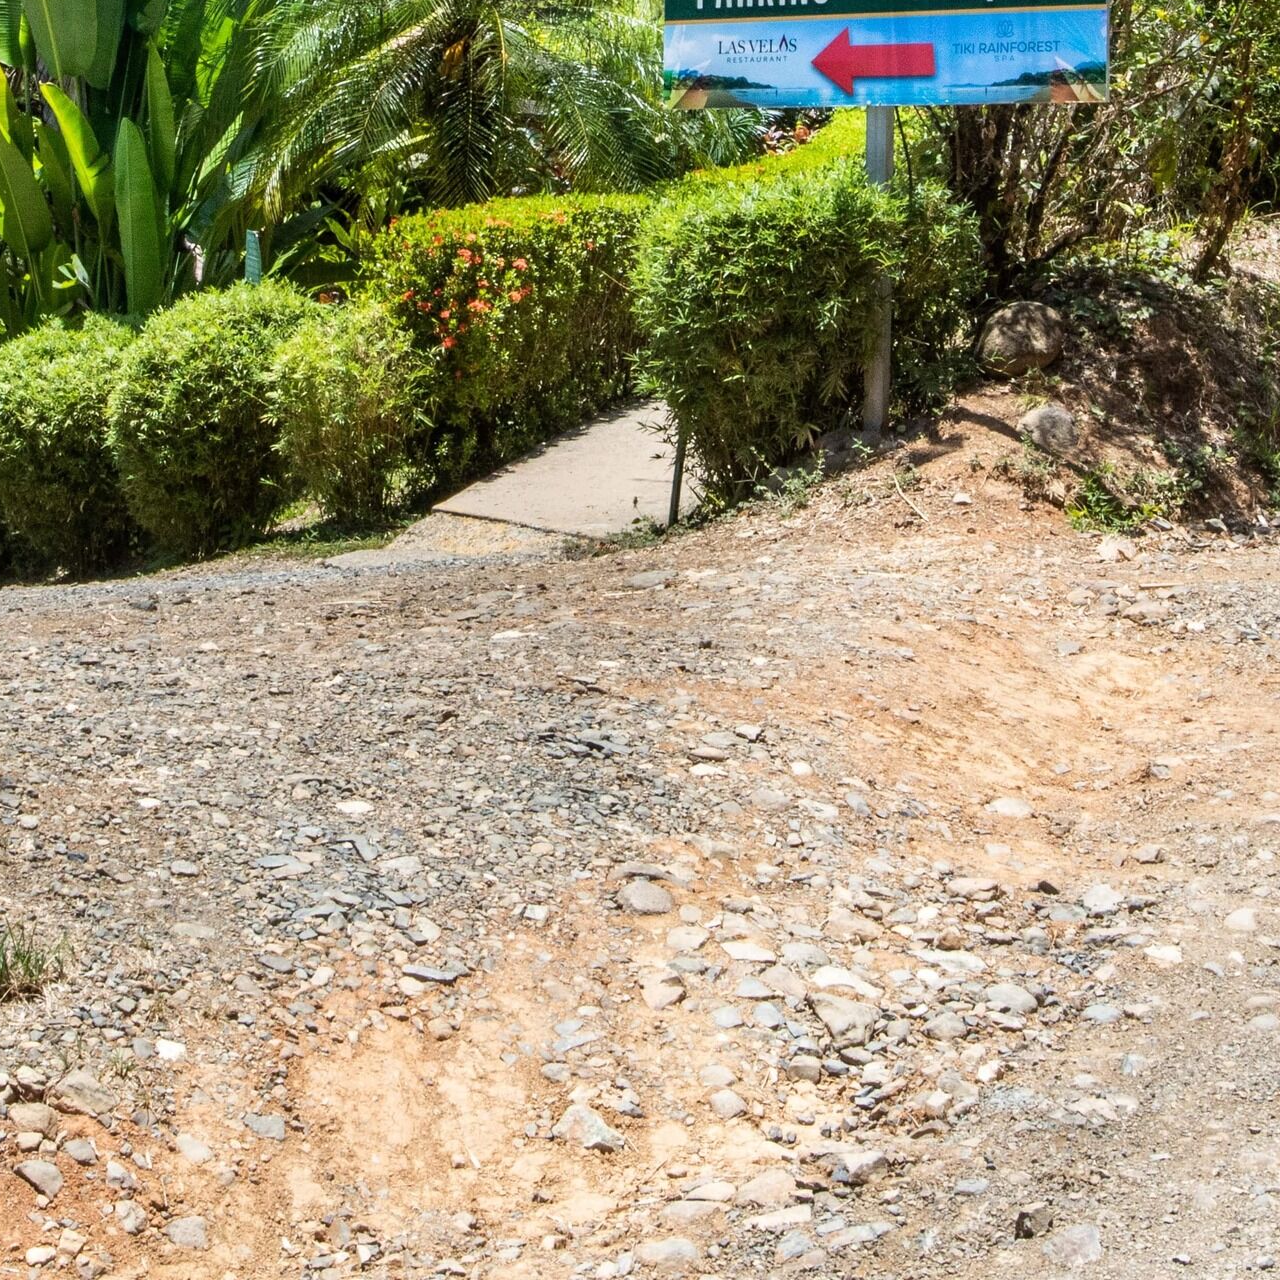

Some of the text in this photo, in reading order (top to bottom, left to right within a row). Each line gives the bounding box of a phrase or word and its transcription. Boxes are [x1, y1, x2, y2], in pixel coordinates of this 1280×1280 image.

[718, 34, 797, 55] LAS VELAS
[952, 40, 1061, 55] TIKI RAINFOREST
[726, 55, 788, 64] RESTAURANT
